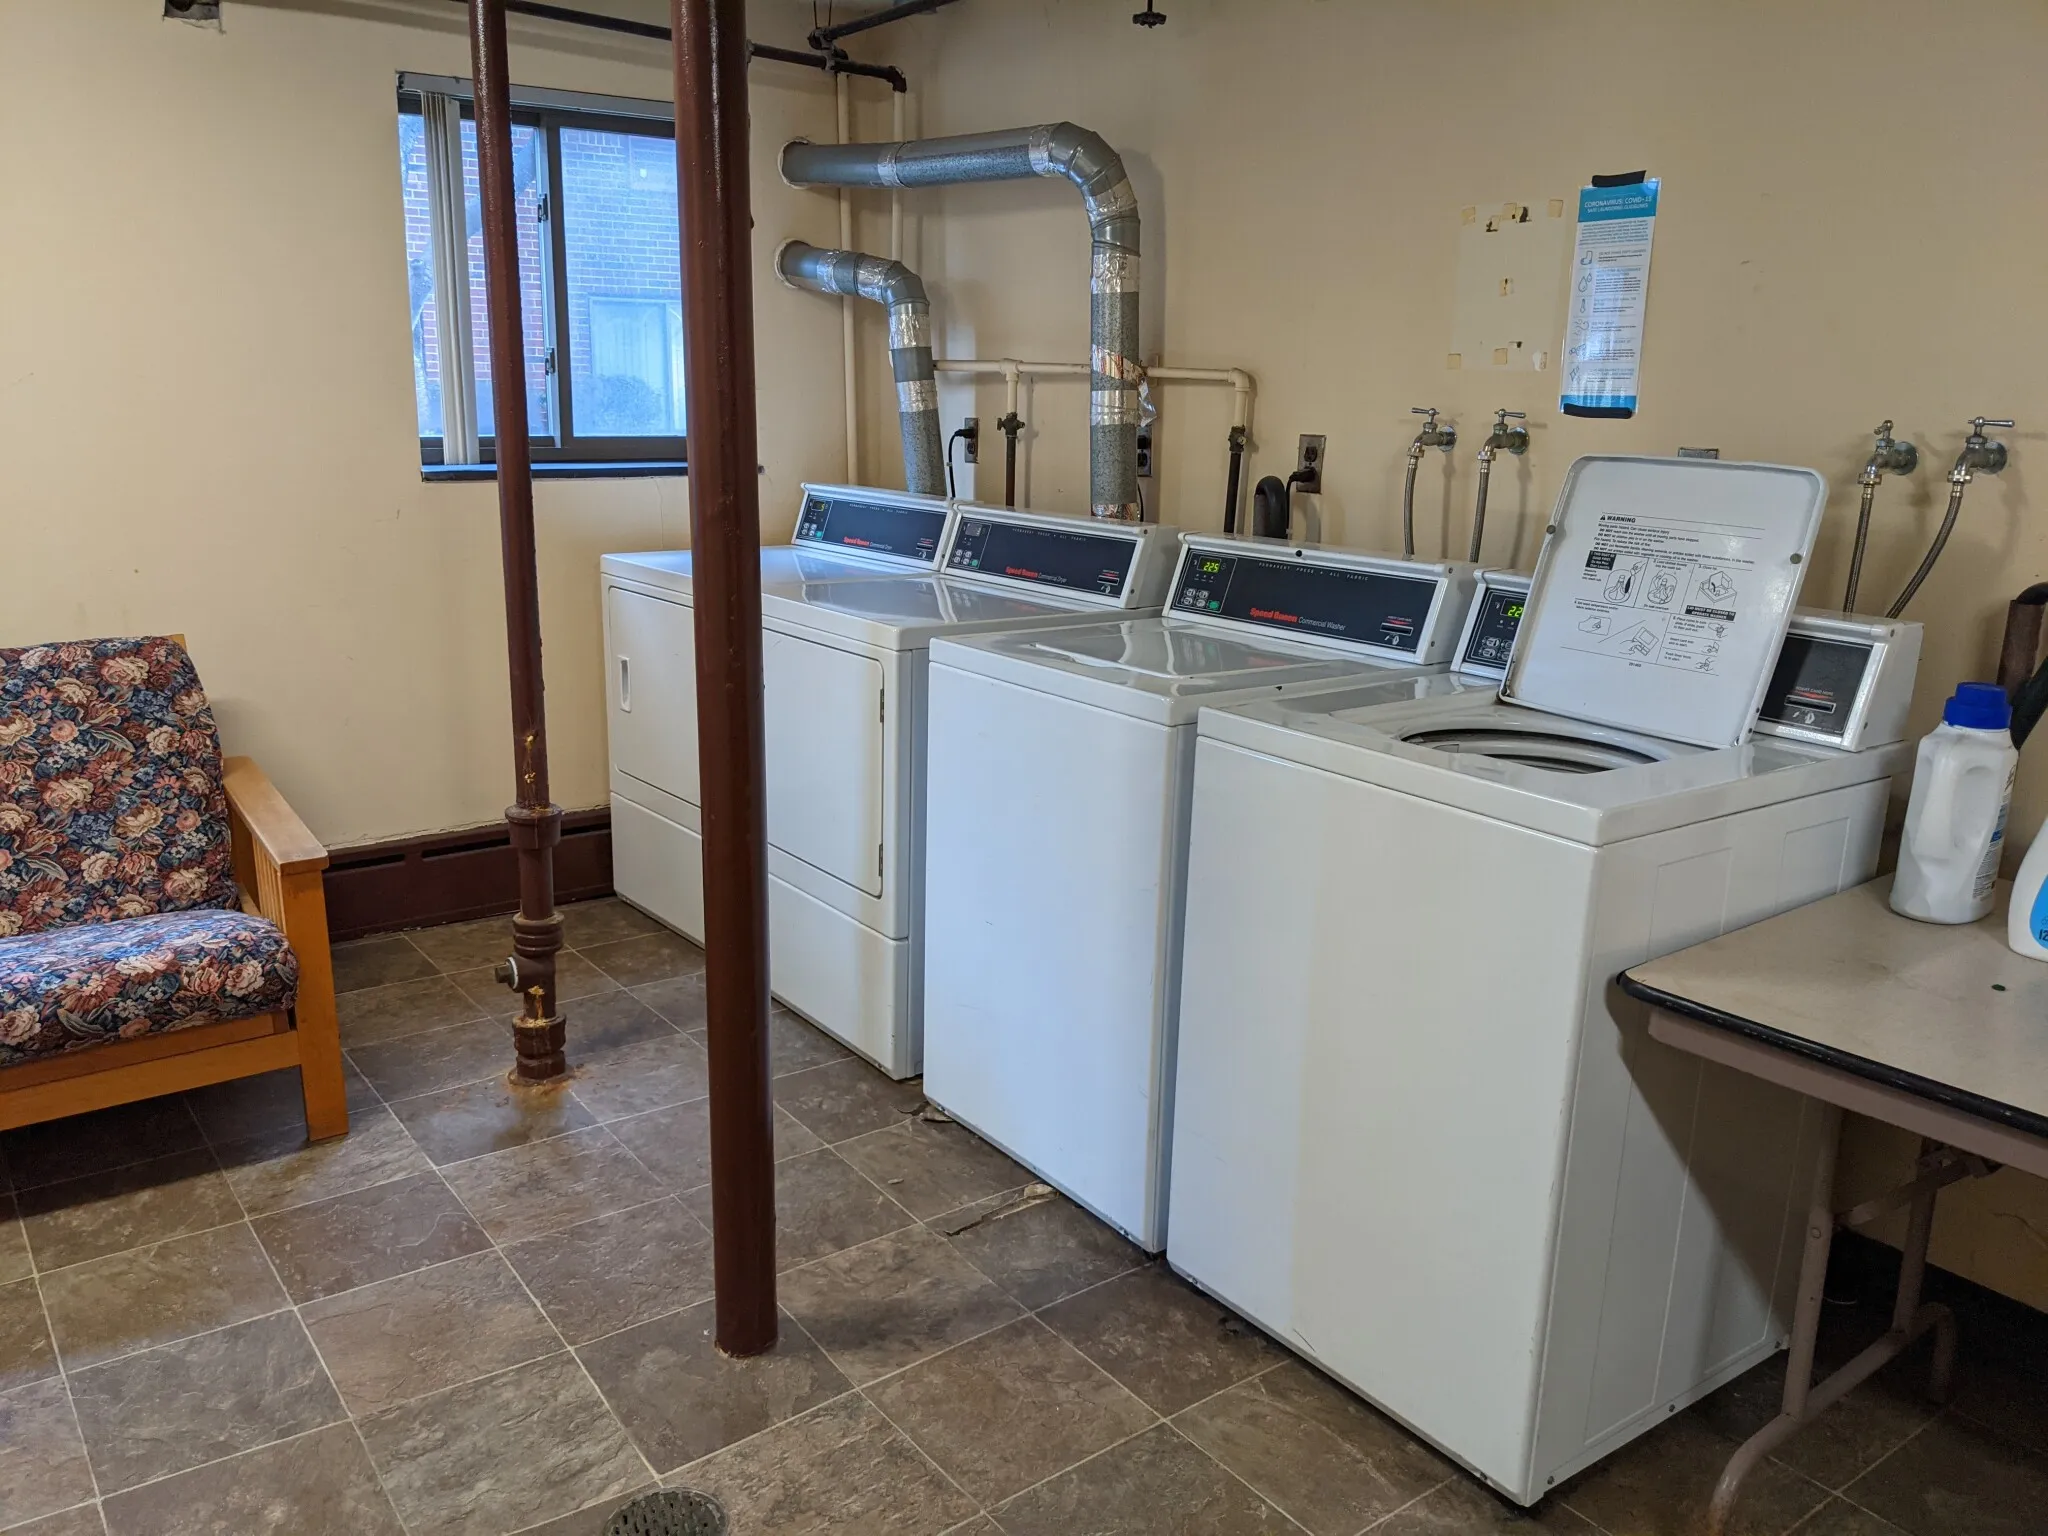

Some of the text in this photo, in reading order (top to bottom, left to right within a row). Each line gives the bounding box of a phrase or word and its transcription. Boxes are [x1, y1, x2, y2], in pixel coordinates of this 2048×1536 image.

[1607, 515, 1636, 523] WARNING
[1203, 562, 1219, 572] 225
[1250, 608, 1346, 631] Speed Queen Commercial Washer
